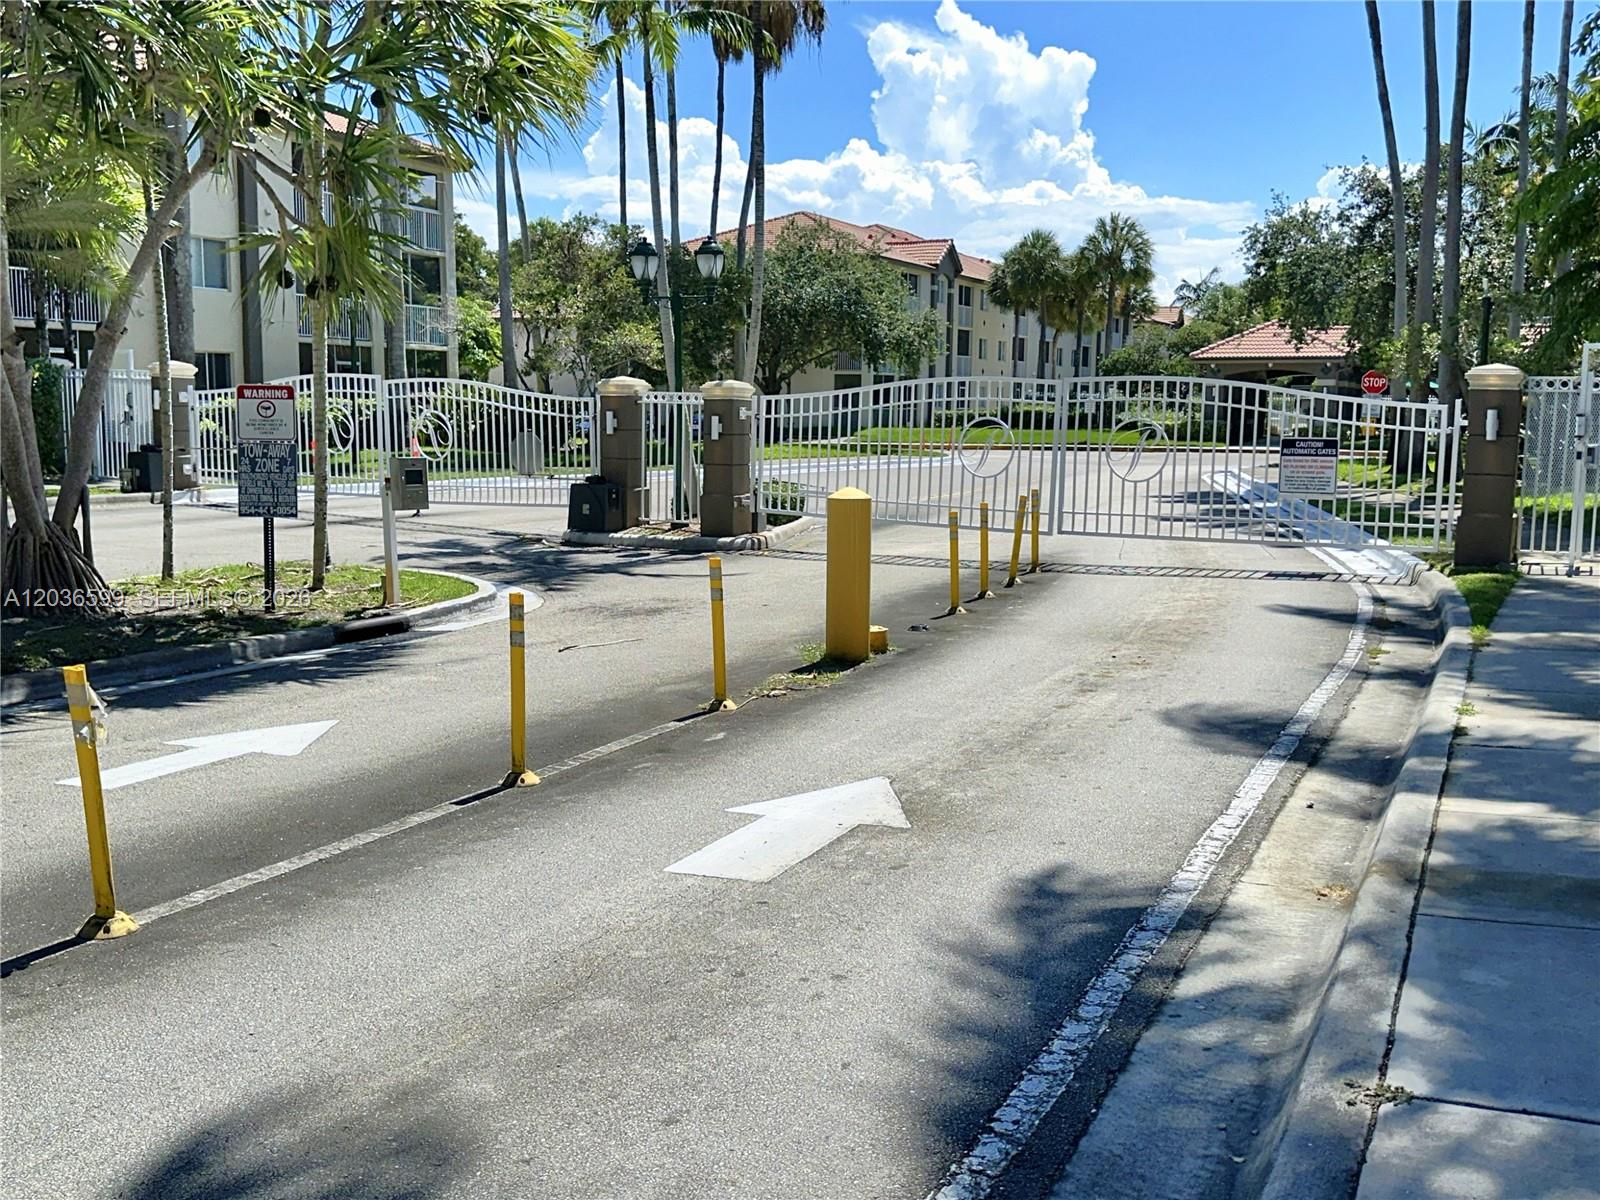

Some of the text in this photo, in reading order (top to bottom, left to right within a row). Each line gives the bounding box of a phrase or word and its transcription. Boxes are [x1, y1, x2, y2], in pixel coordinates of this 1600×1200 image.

[1363, 377, 1386, 387] STOP
[243, 388, 288, 399] WARNING
[242, 443, 290, 458] TOW-AWAY
[240, 457, 250, 465] 24
[255, 458, 280, 473] ZONE
